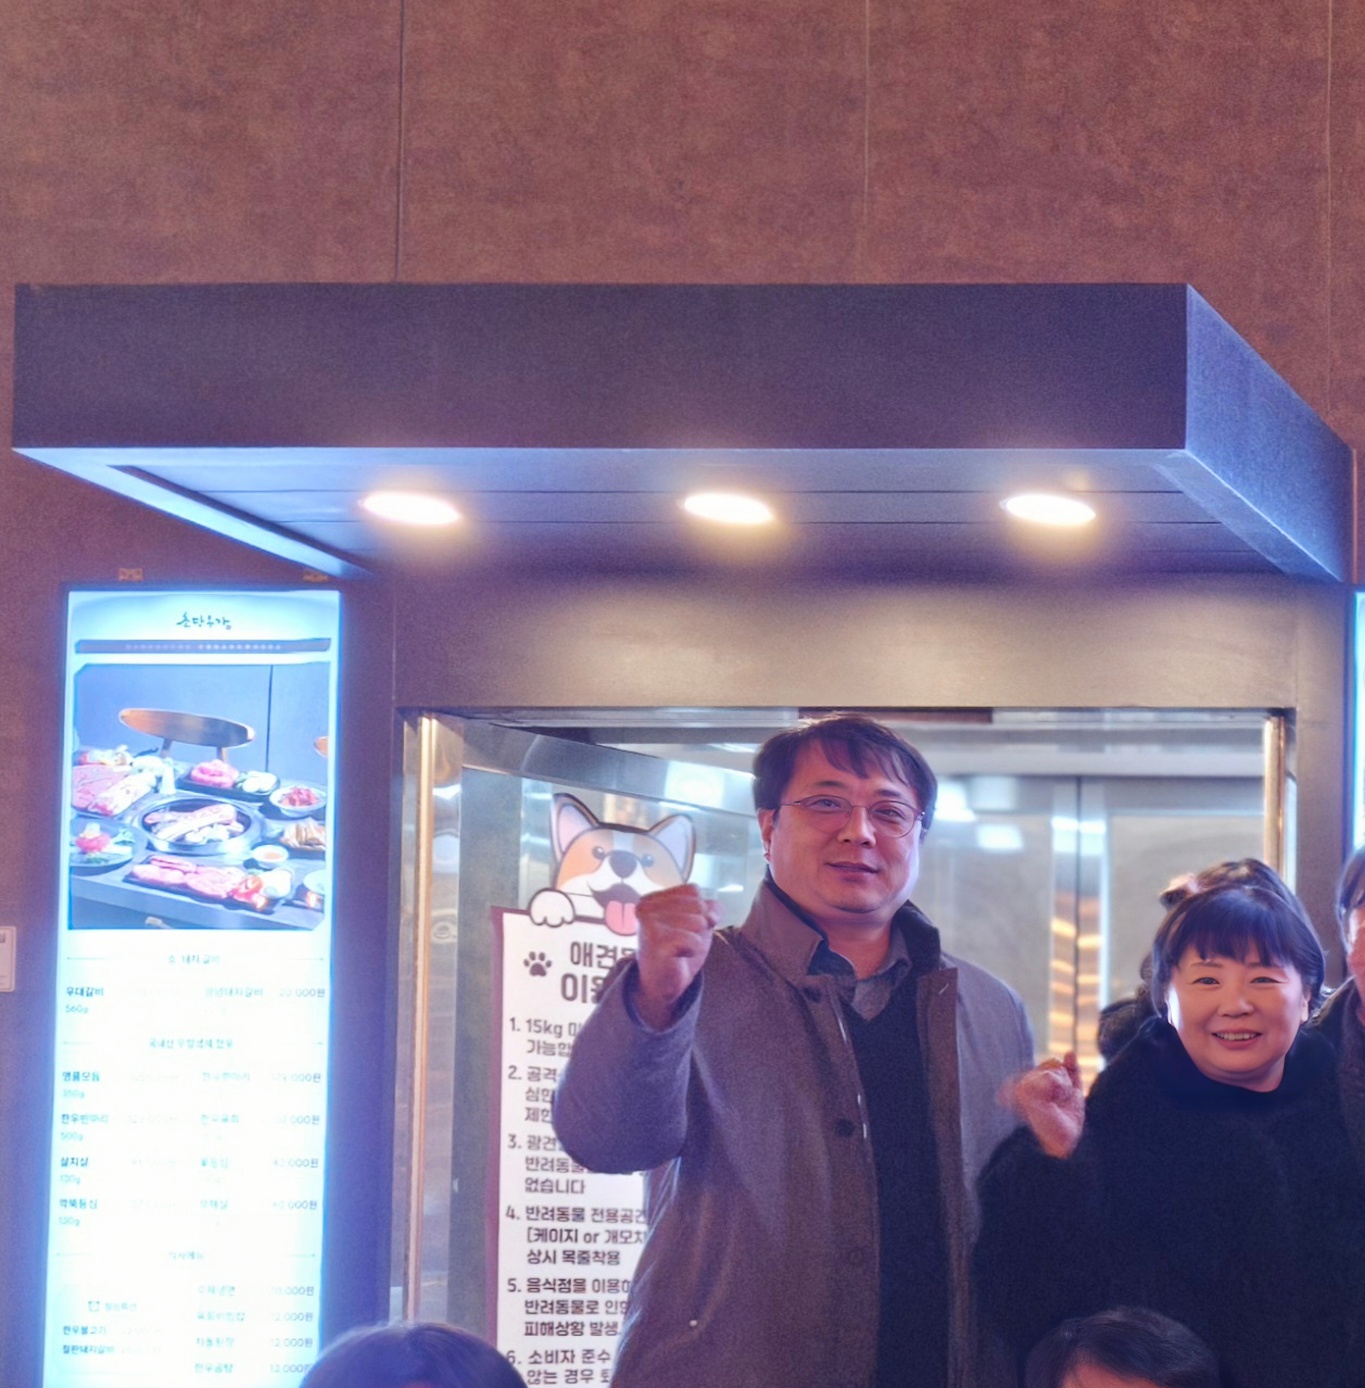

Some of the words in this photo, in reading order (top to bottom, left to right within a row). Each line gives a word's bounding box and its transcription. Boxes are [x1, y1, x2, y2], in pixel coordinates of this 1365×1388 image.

[526, 1018, 563, 1039] 15kg
[525, 1177, 585, 1194] 없습니다
[506, 1205, 520, 1220] 4.
[526, 1205, 585, 1223] 반려동물
[526, 1227, 578, 1244] [케이지
[583, 1232, 600, 1244] or
[526, 1249, 557, 1266] 상시
[562, 1250, 621, 1266] 목줄착용
[507, 1278, 522, 1293] 5.
[526, 1278, 587, 1293] 음식점을
[524, 1300, 599, 1315] 반려동물로
[524, 1321, 584, 1337] 피해상황
[528, 1349, 576, 1365] 소비자
[581, 1348, 611, 1364] 준수
[527, 1369, 557, 1385] 않는
[564, 1369, 595, 1384] 경우
